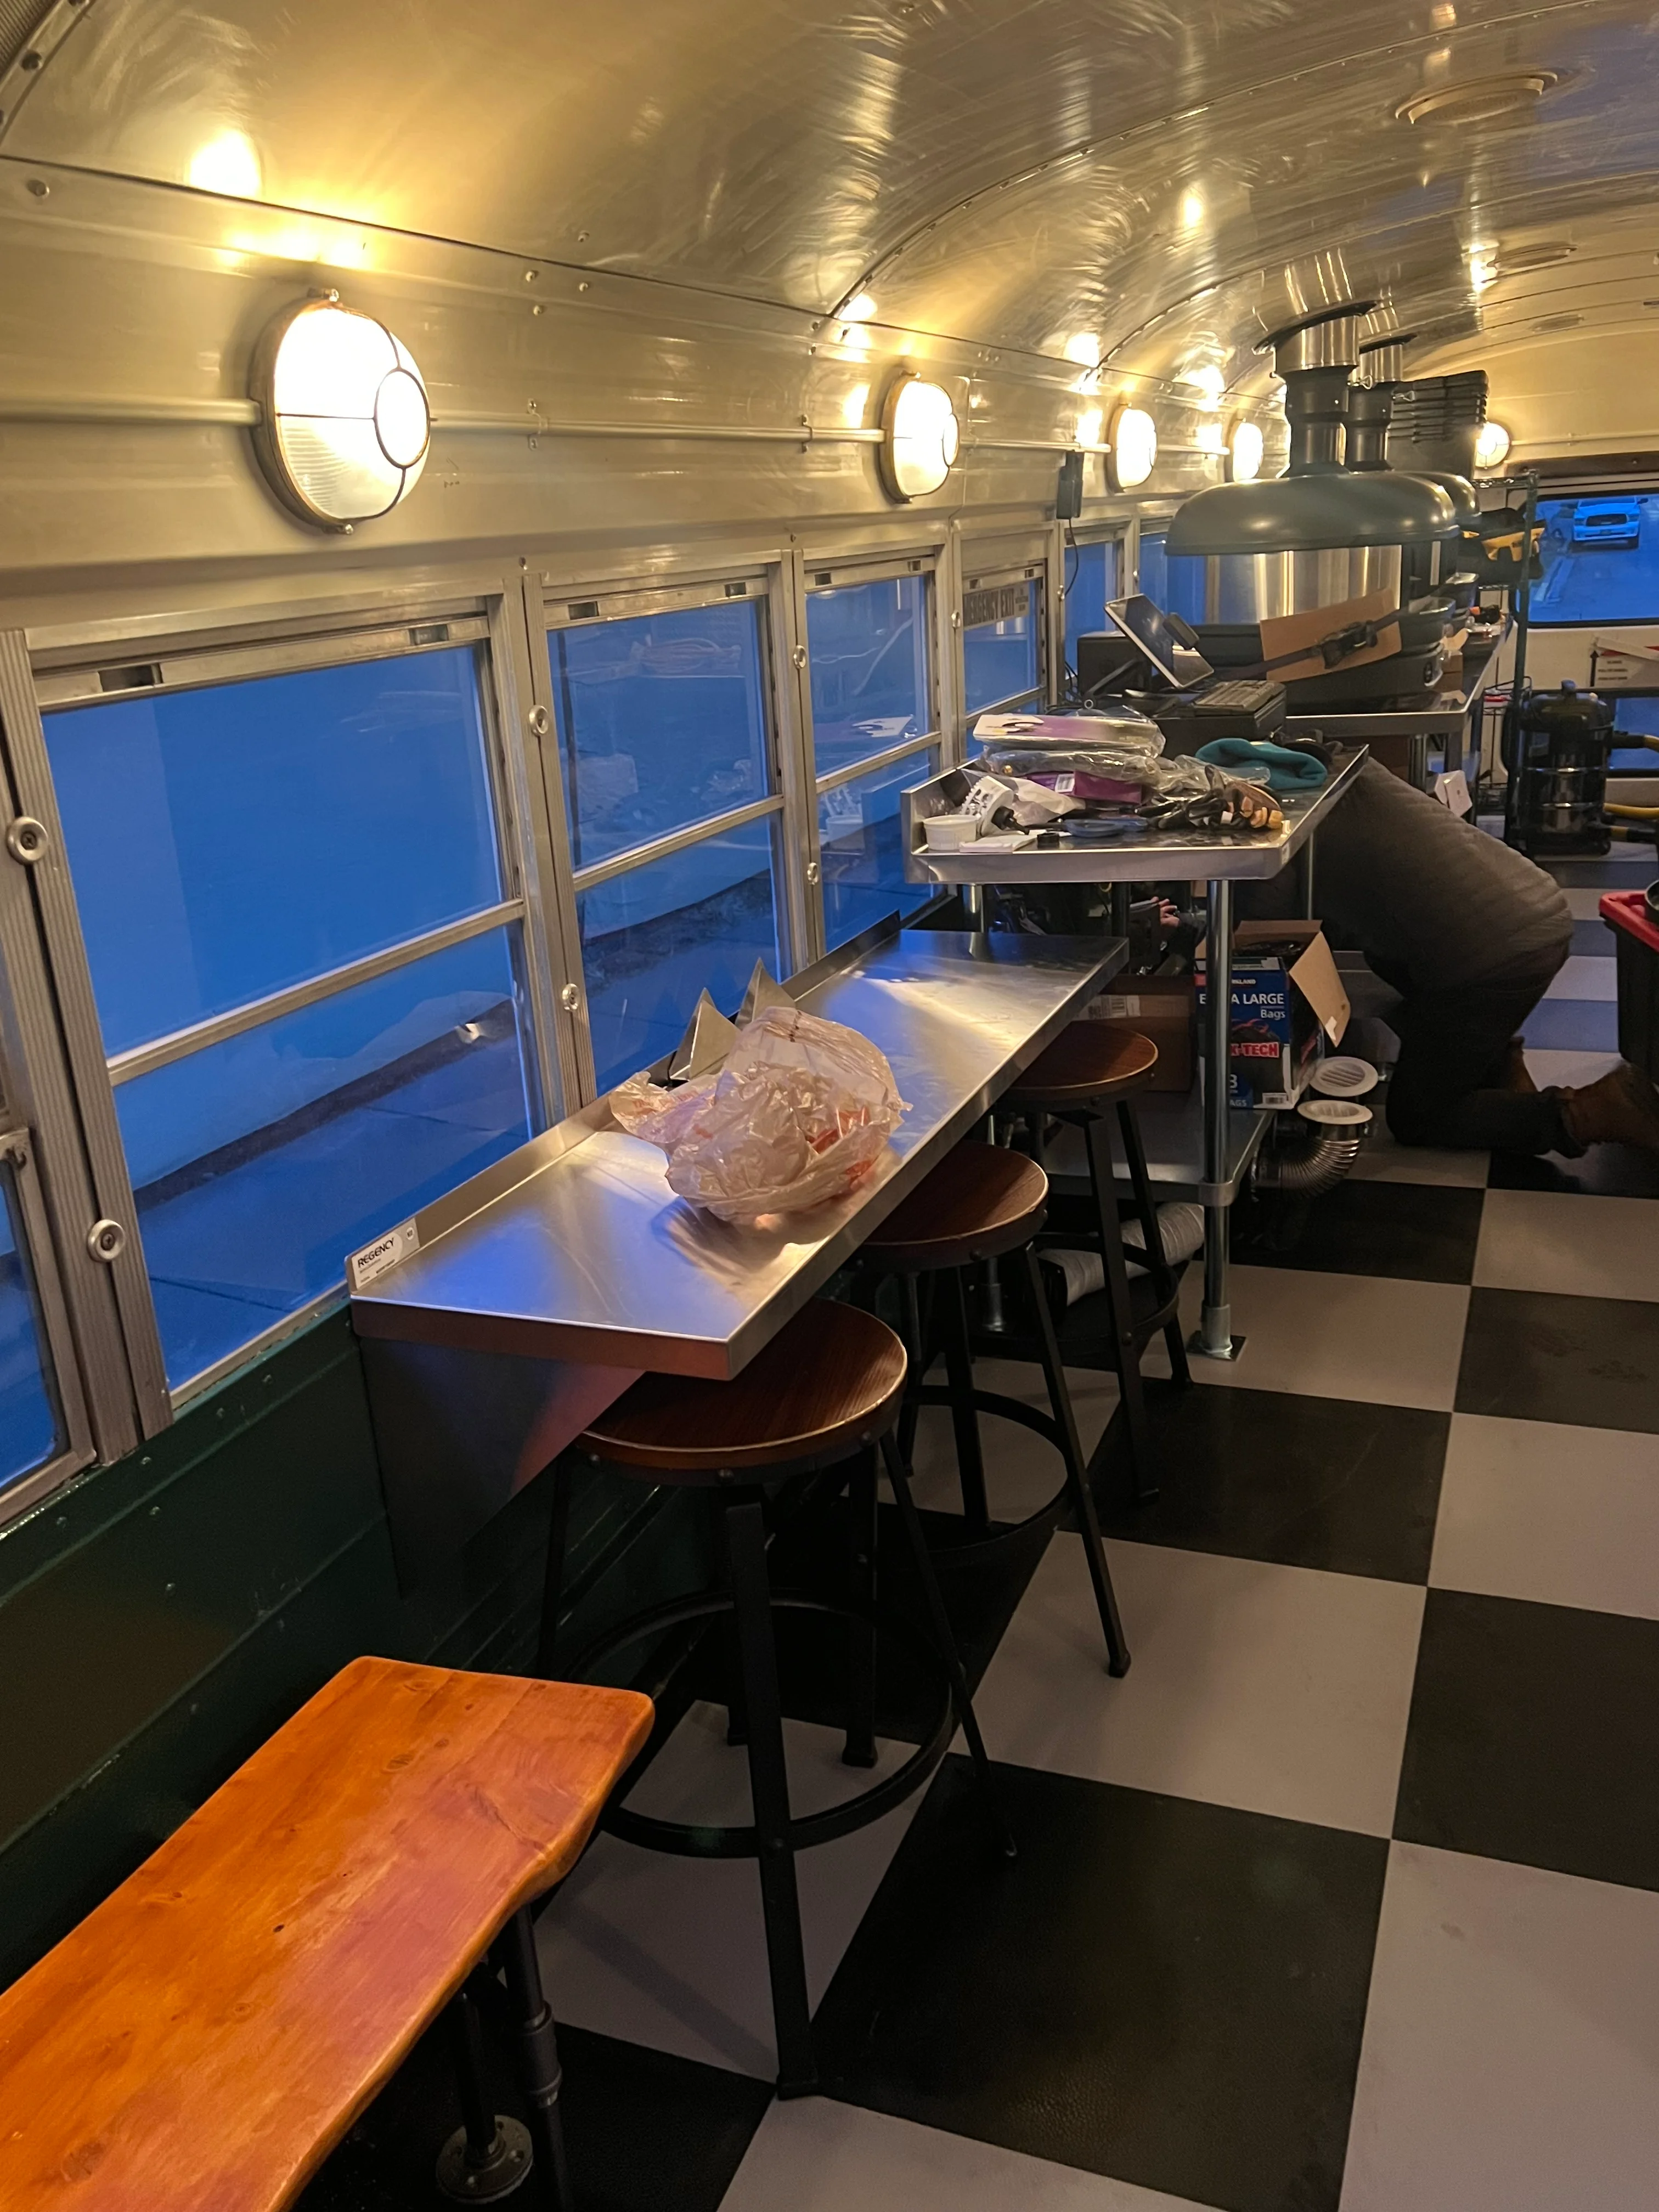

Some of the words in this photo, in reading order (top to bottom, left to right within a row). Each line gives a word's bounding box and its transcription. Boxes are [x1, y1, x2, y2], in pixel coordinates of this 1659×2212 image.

[1243, 993, 1284, 1005] LARGE
[1260, 1009, 1285, 1020] Bags
[1229, 1099, 1247, 1107] AGS
[357, 1237, 394, 1268] REGENCY
